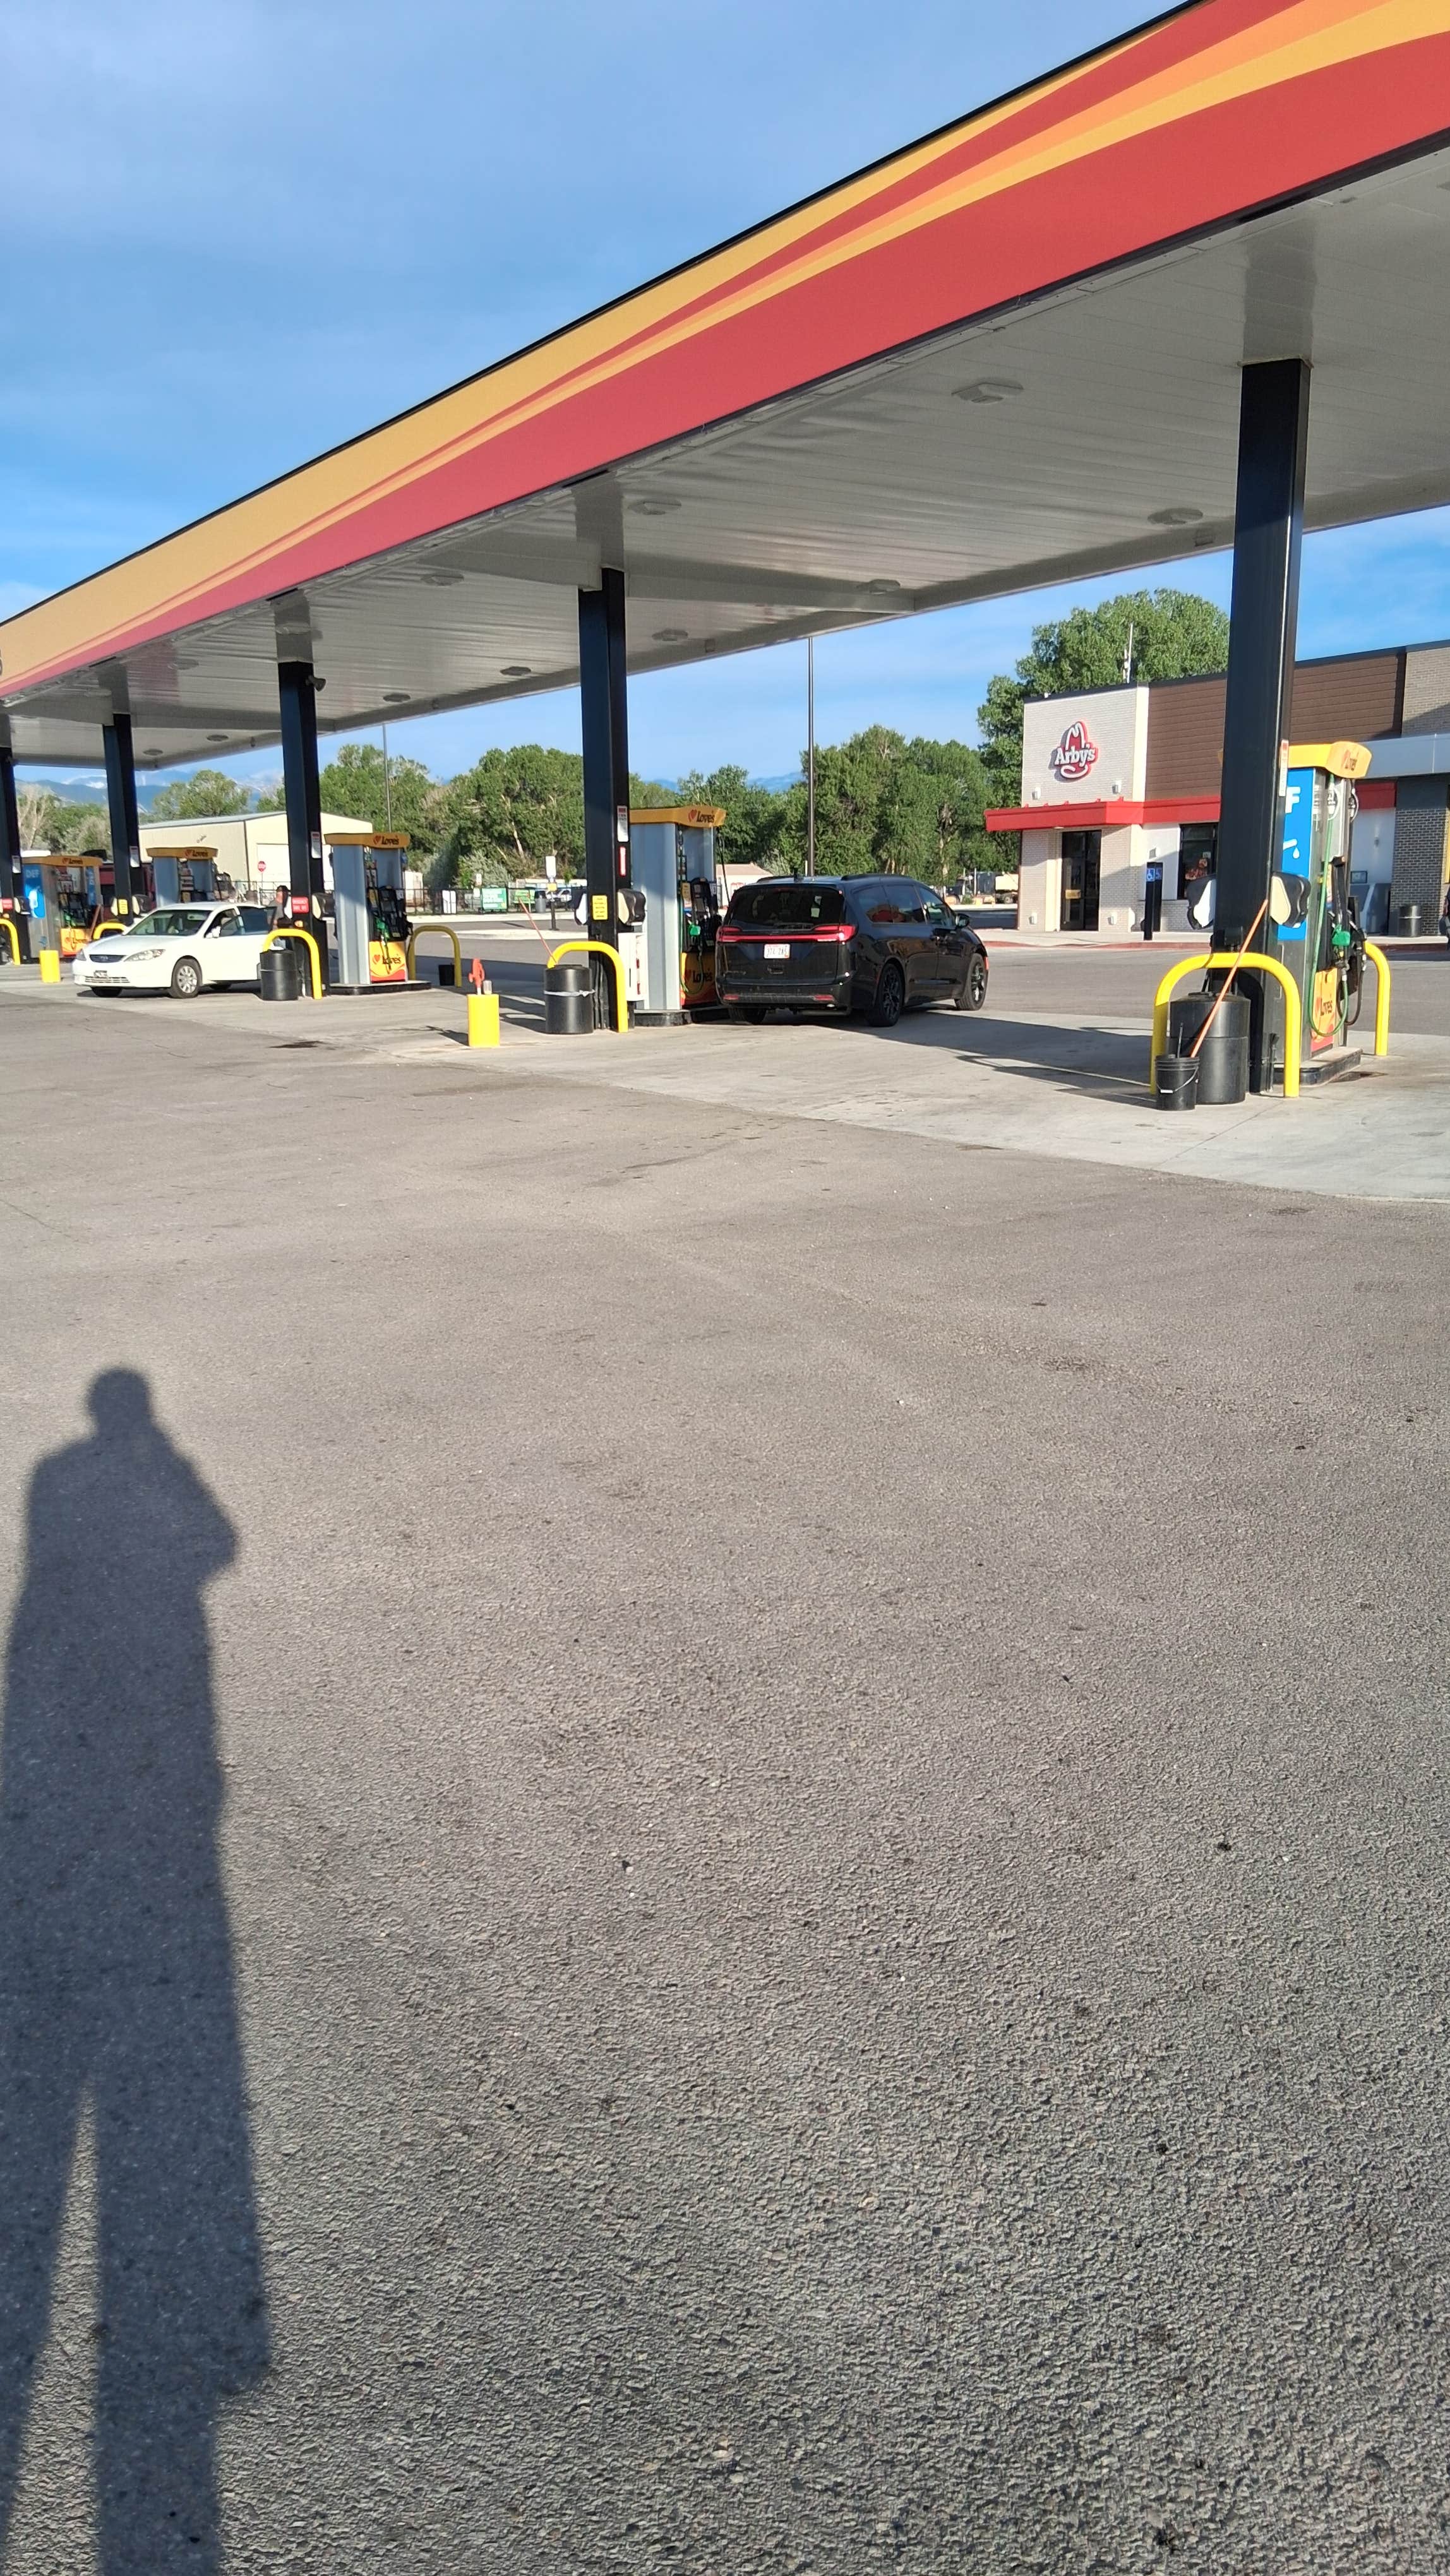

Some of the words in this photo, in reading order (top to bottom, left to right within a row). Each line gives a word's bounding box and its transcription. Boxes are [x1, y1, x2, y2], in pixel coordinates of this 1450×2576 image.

[1054, 744, 1096, 767] Arby's
[696, 810, 716, 823] Love's
[381, 835, 400, 845] Love's
